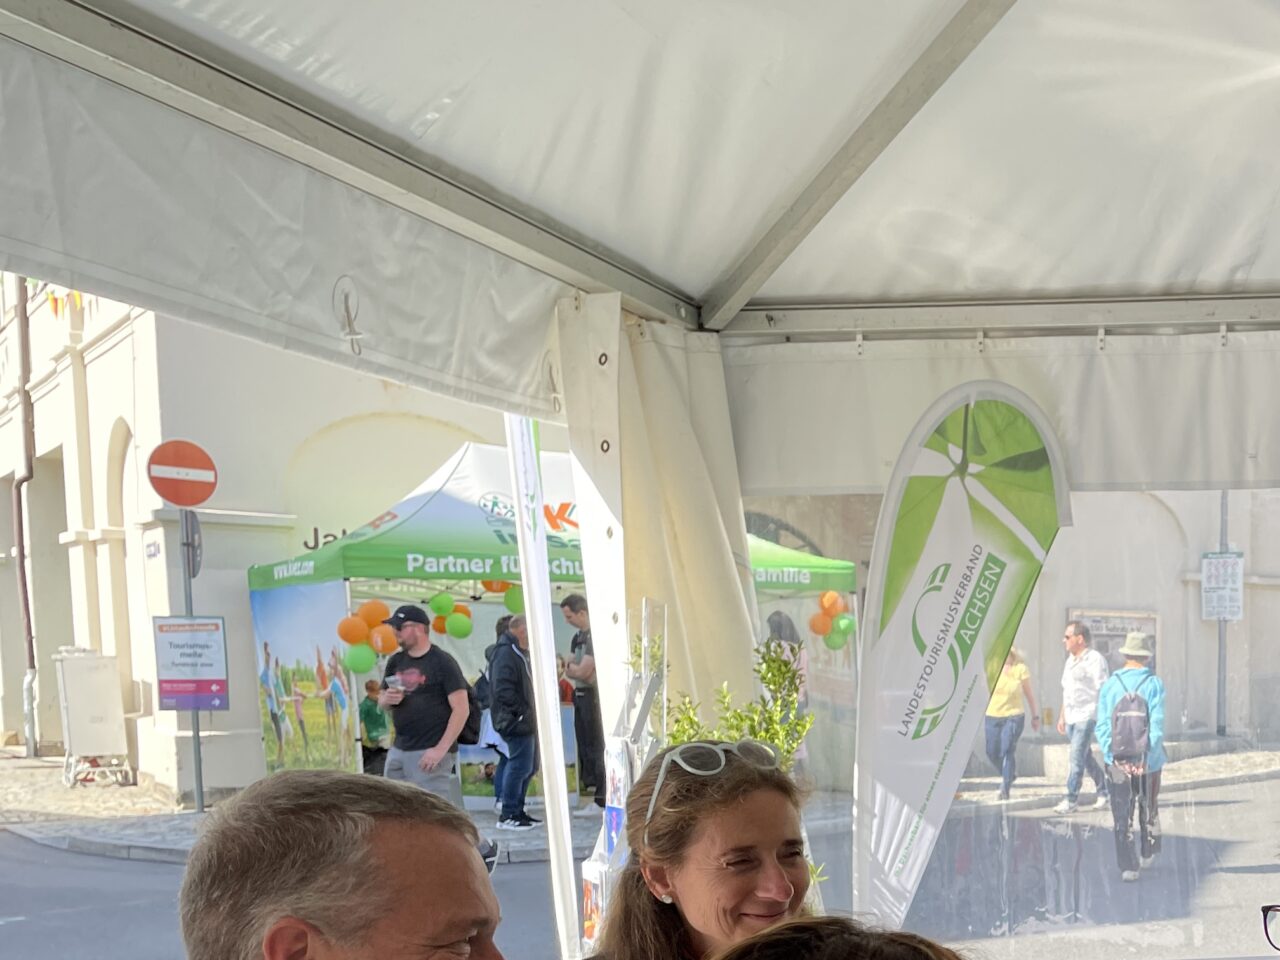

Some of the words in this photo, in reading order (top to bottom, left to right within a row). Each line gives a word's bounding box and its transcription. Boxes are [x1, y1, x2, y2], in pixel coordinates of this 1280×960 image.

[406, 553, 494, 574] Partner
[501, 555, 524, 574] fü
[755, 567, 811, 584] amilie
[898, 544, 983, 737] LANDESTOURISMUSVERBAND
